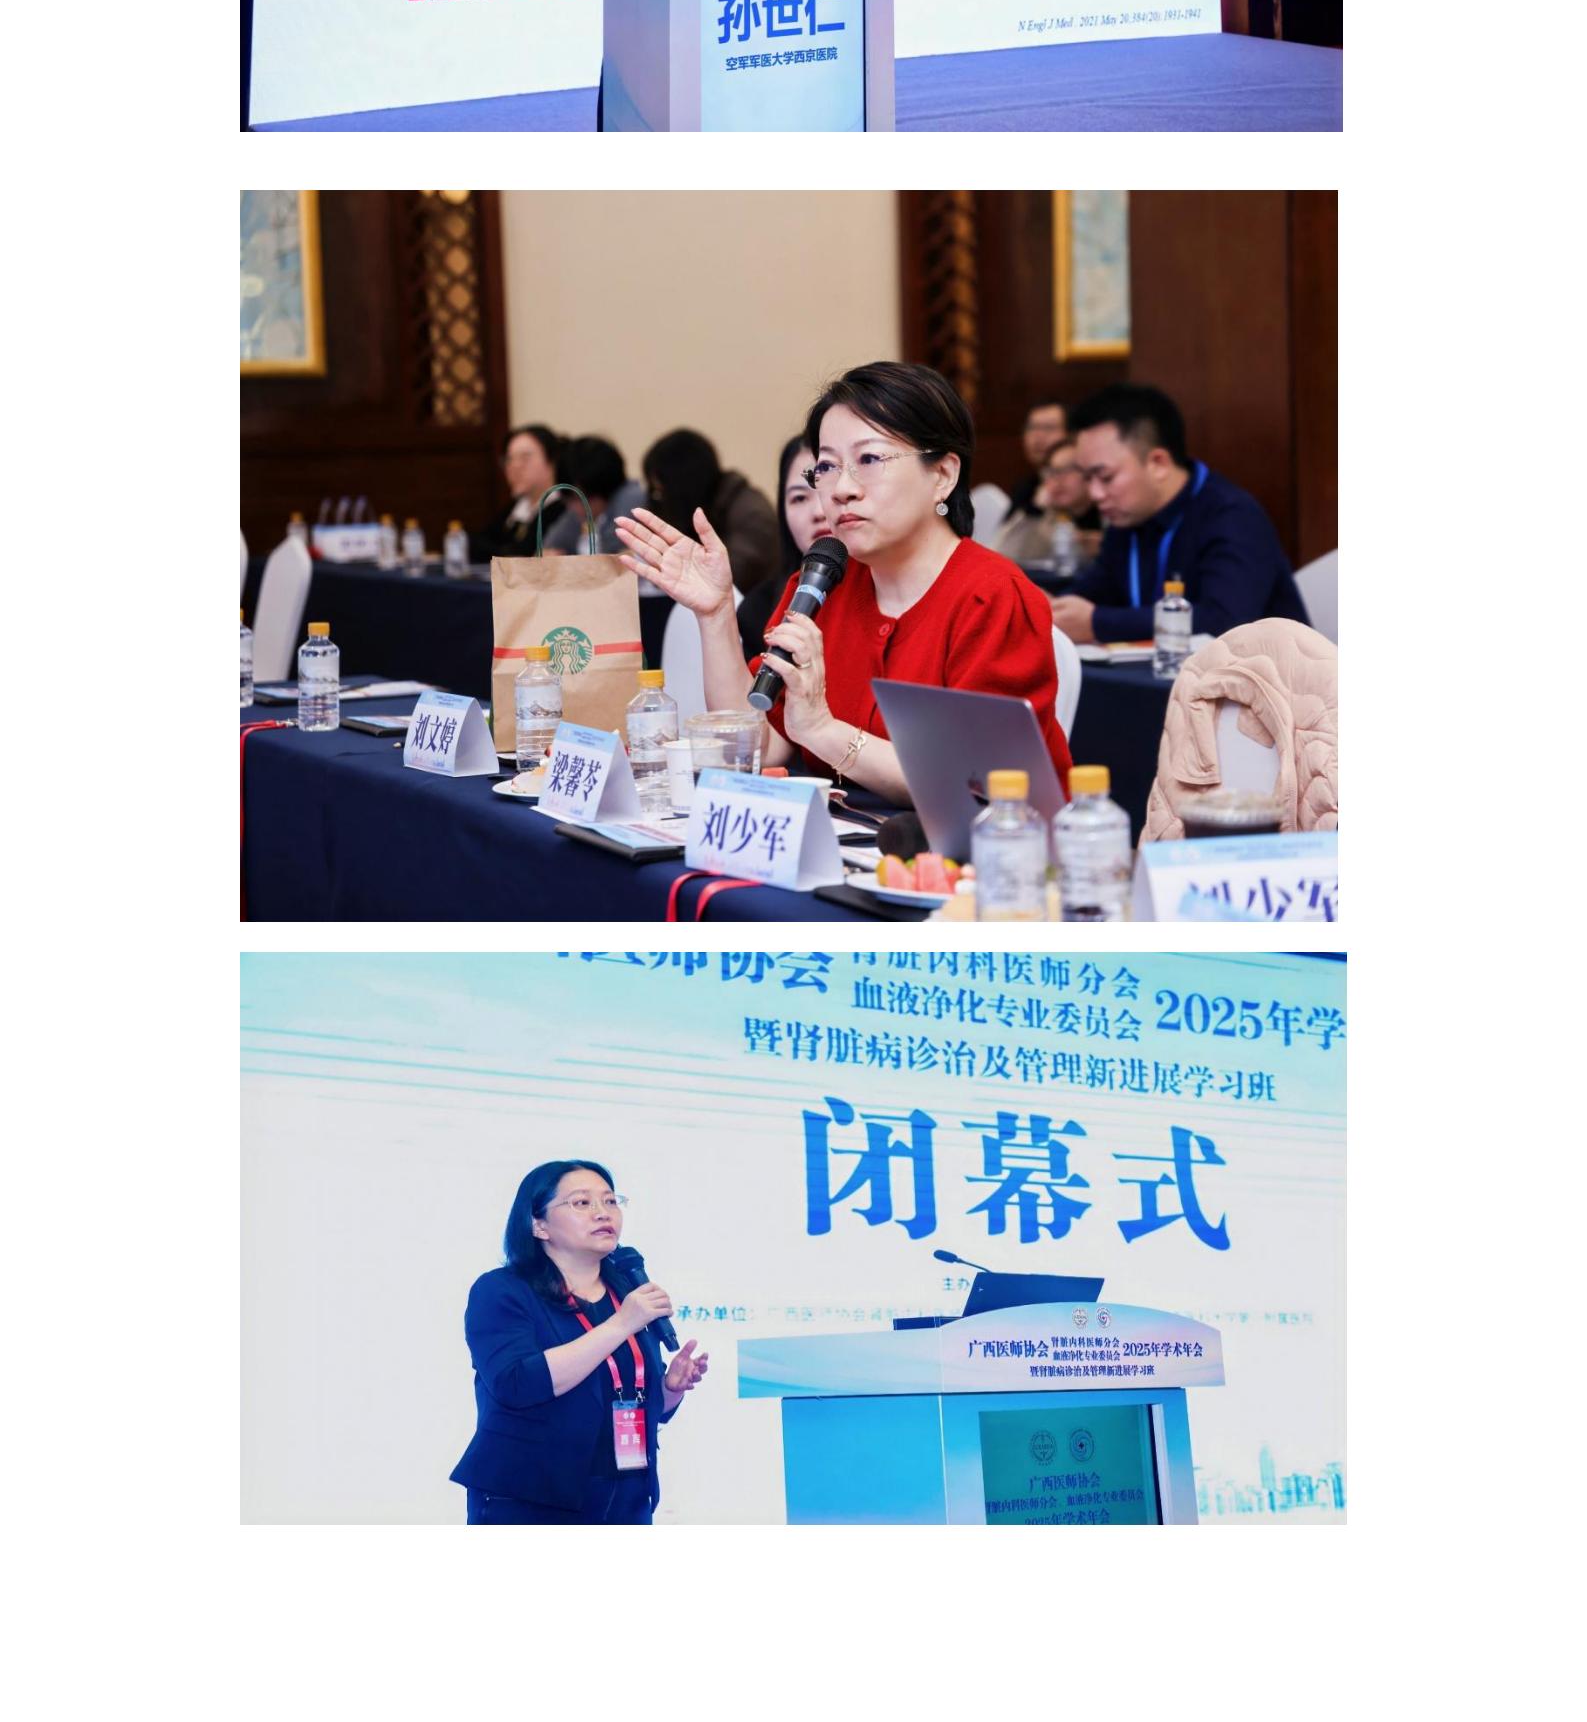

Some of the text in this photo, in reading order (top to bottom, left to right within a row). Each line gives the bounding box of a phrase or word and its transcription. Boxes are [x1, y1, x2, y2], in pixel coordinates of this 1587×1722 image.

[725, 46, 838, 72] 空军军医大学西京医院
[411, 712, 458, 755] 刘文婷
[549, 750, 602, 803] 梁馨苓
[700, 801, 792, 862] 刘少军
[850, 975, 1143, 1043] 血液净化专业委员会
[1154, 988, 1347, 1051] 2025年学
[743, 1017, 1277, 1102] 暨肾脏病诊治及管理新进展学习班
[800, 1096, 1232, 1251] 闭幕式
[968, 1339, 1049, 1359] 广西医师协会
[1051, 1336, 1120, 1348] 肾脏内科医师分会
[1052, 1350, 1121, 1362] 血液净化专业委员会
[1122, 1340, 1204, 1358] 2025年学术年会
[1029, 1471, 1101, 1492] 广西医师协会
